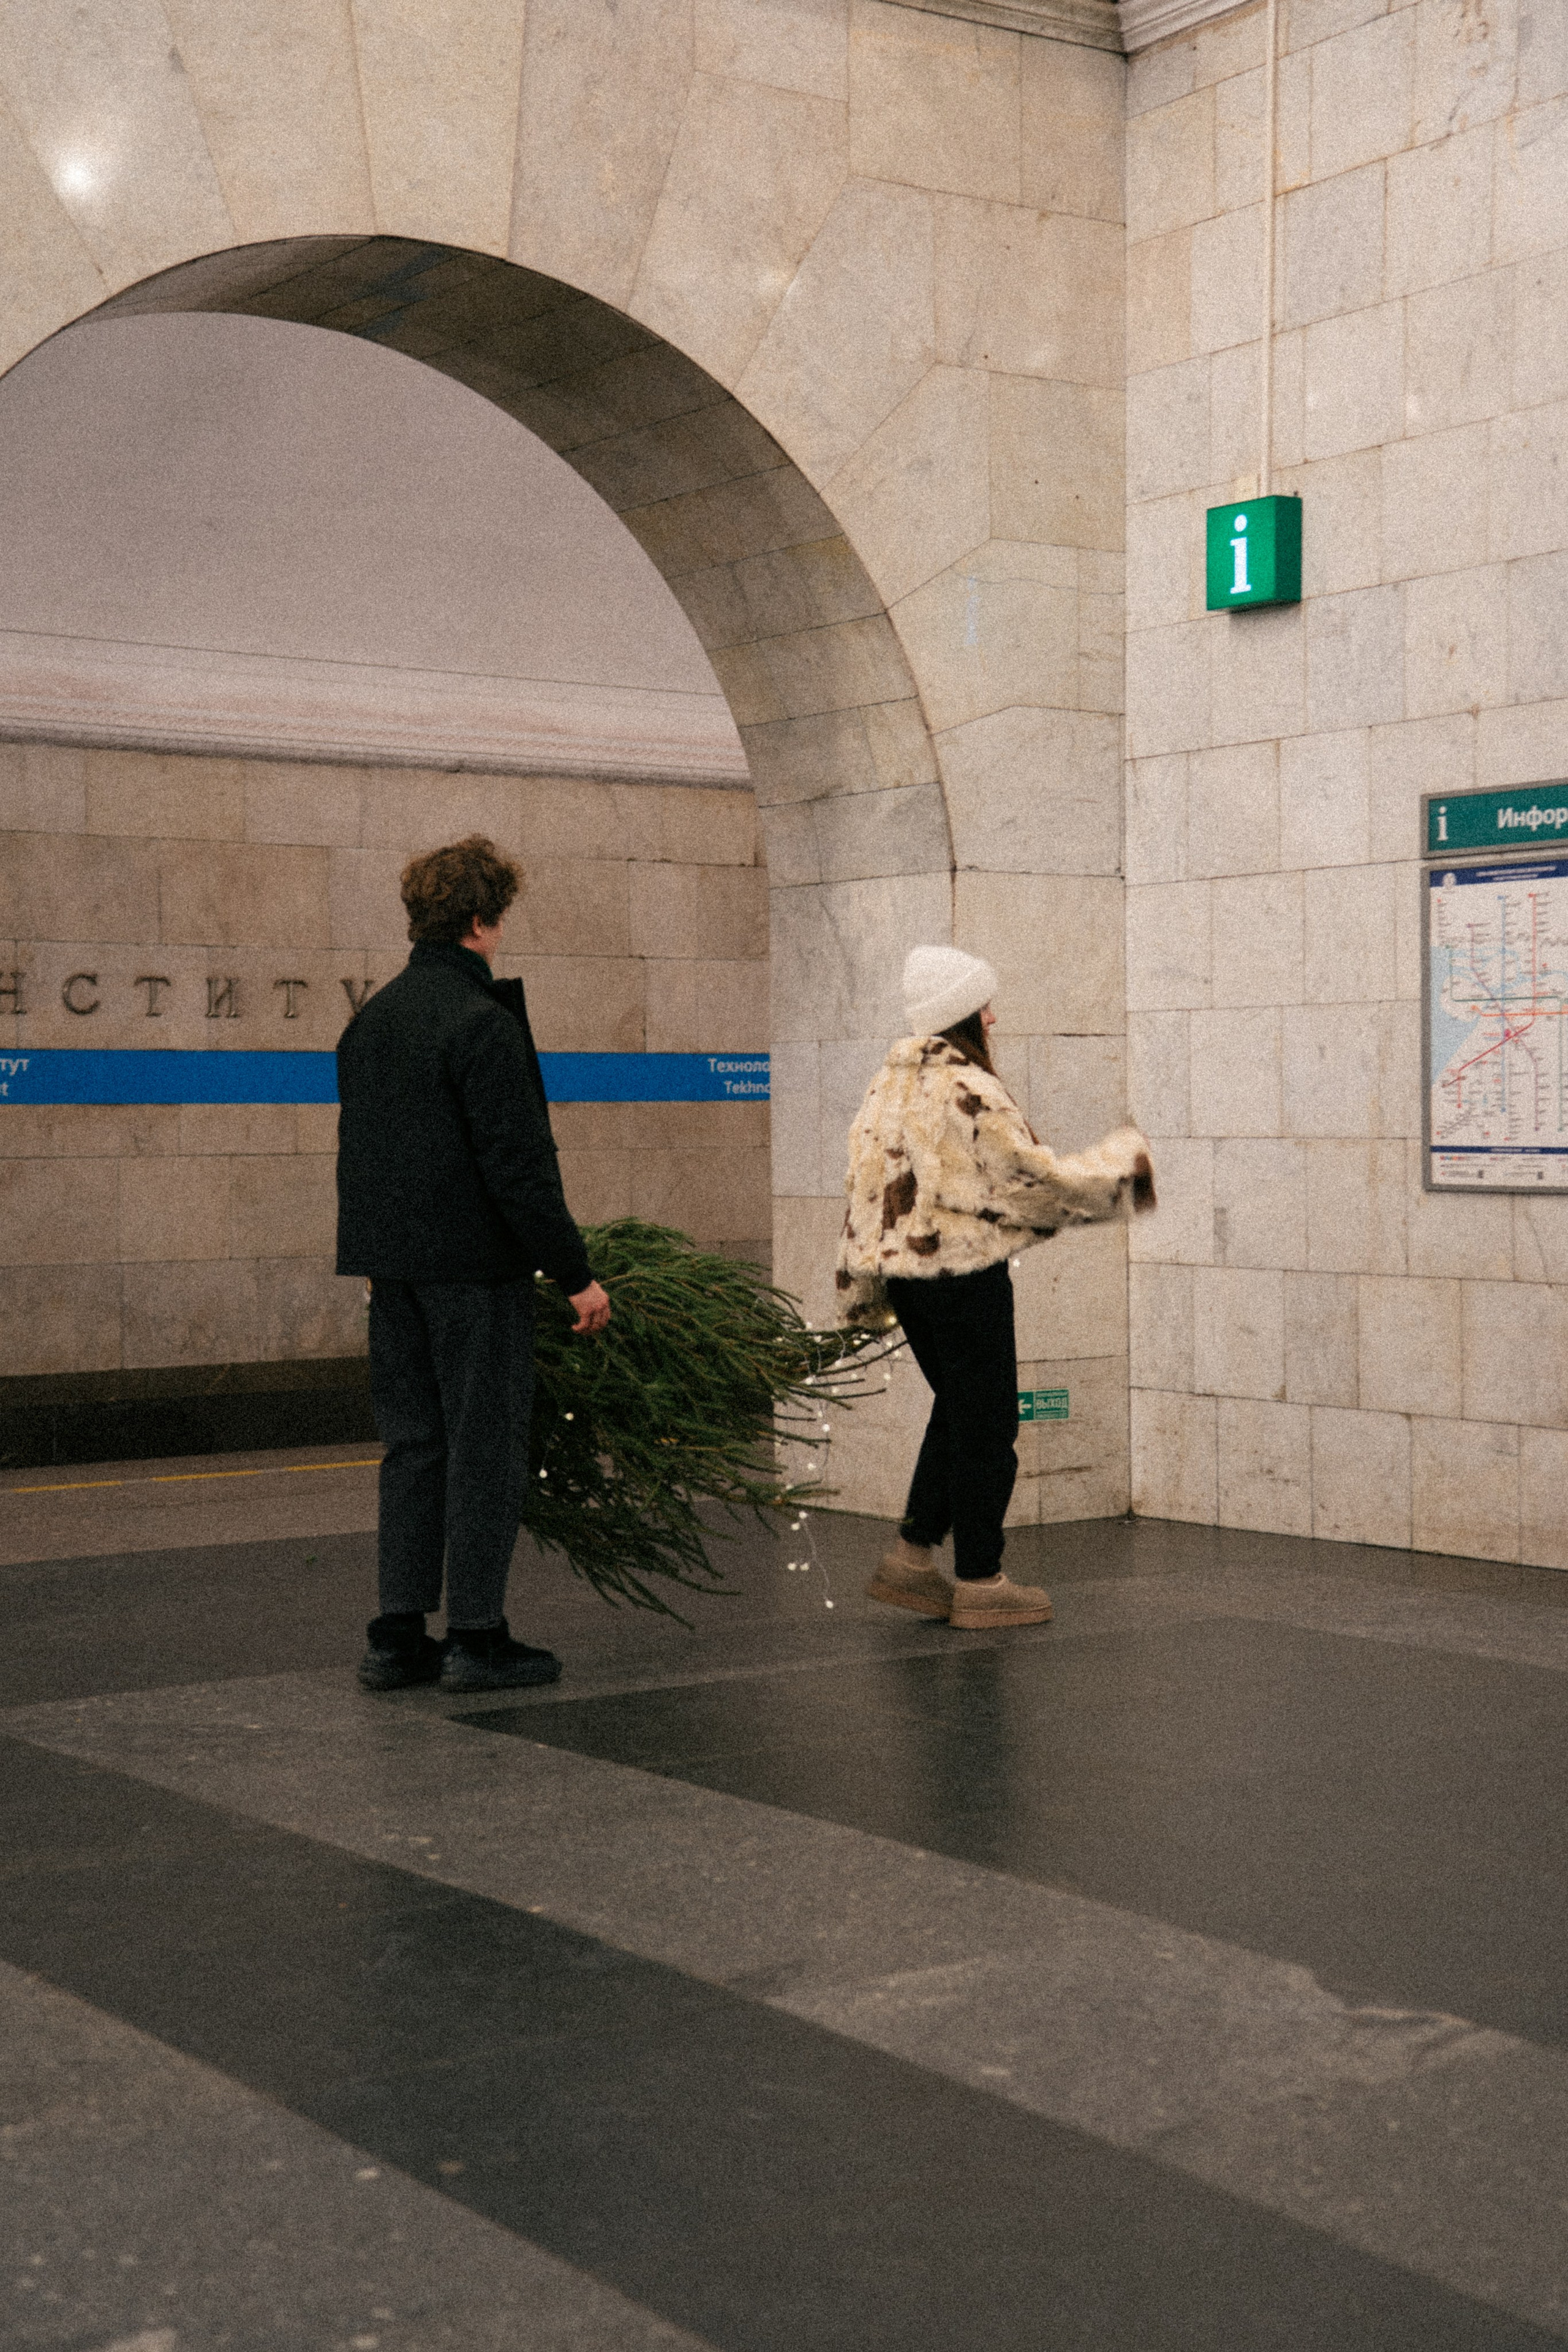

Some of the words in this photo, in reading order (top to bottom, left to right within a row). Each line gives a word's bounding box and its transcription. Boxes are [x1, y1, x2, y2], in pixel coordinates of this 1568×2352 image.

[1230, 514, 1251, 594] i
[1437, 806, 1449, 841] i
[1498, 805, 1568, 831] Инфор
